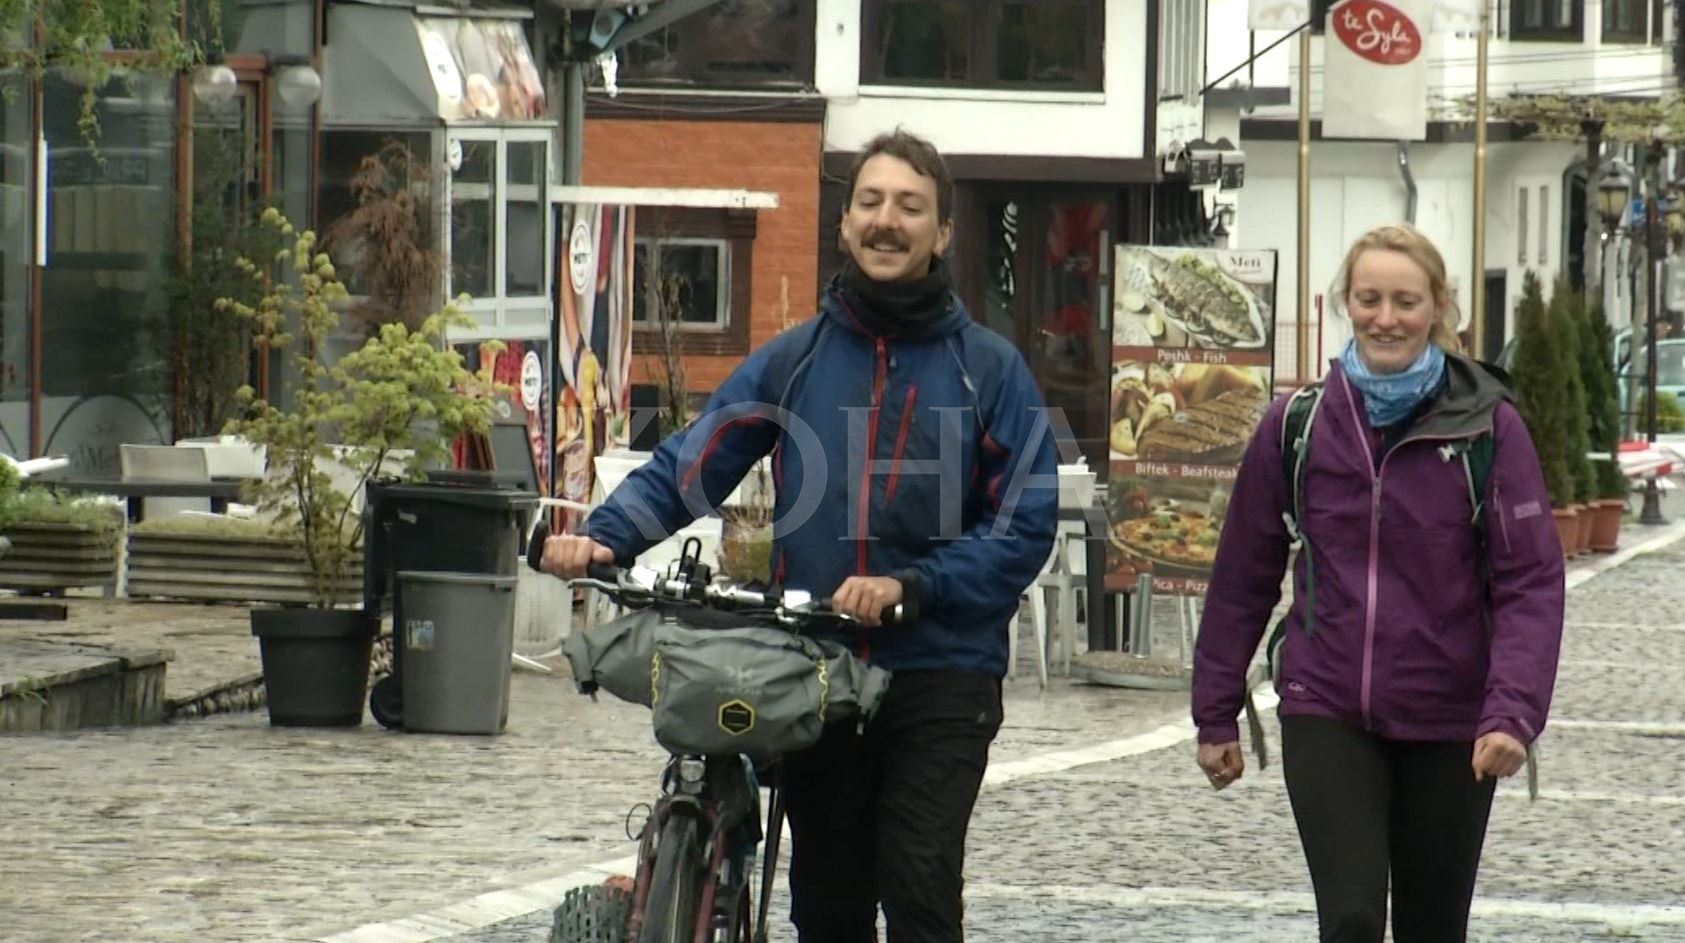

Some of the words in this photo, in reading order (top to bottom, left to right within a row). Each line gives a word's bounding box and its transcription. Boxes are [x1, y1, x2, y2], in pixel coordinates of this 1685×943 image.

[1341, 8, 1363, 30] te
[1157, 347, 1191, 362] Peshk
[1202, 350, 1227, 363] Fish
[1135, 462, 1169, 475] Biftek
